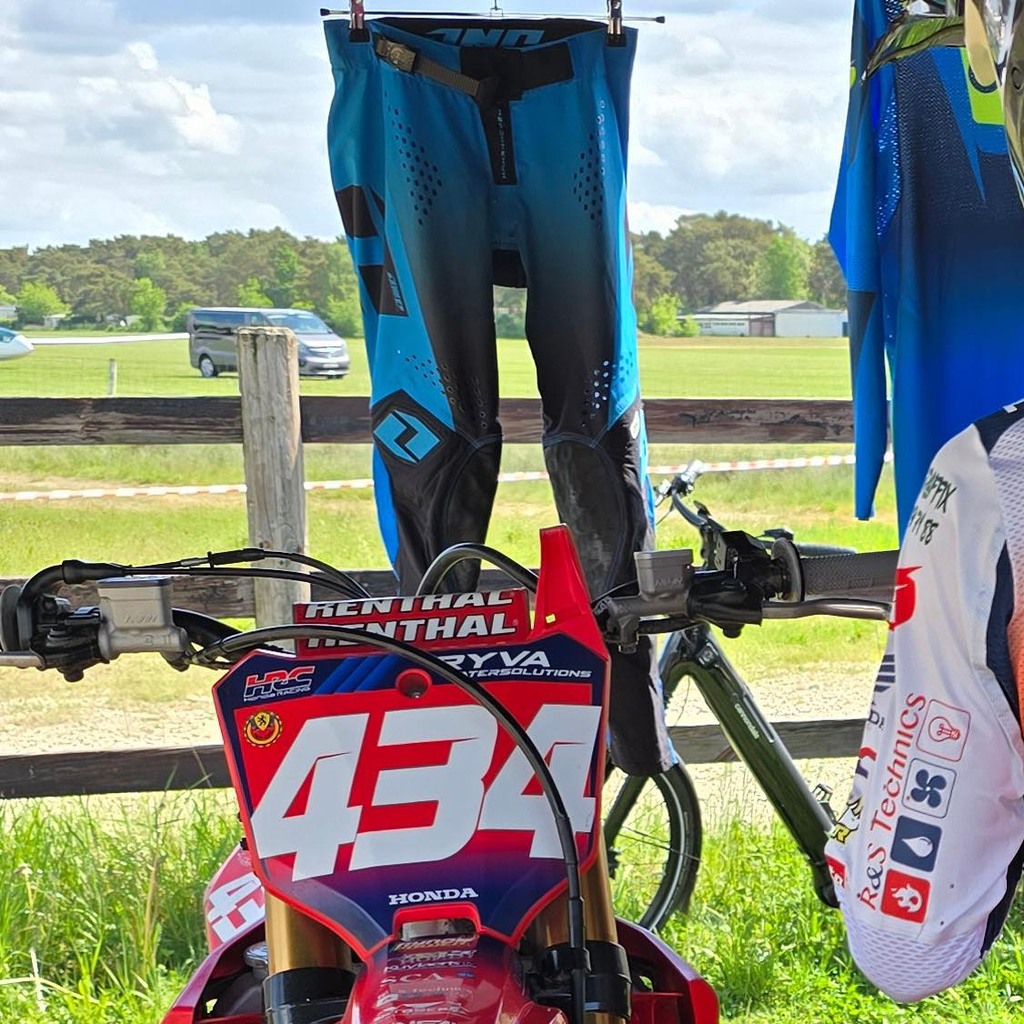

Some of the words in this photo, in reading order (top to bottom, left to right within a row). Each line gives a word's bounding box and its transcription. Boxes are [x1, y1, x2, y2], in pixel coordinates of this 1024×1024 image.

[438, 650, 551, 670] RYVA
[461, 668, 592, 678] TERSOLUTIONS
[250, 704, 602, 881] 434
[389, 888, 478, 905] HONDA
